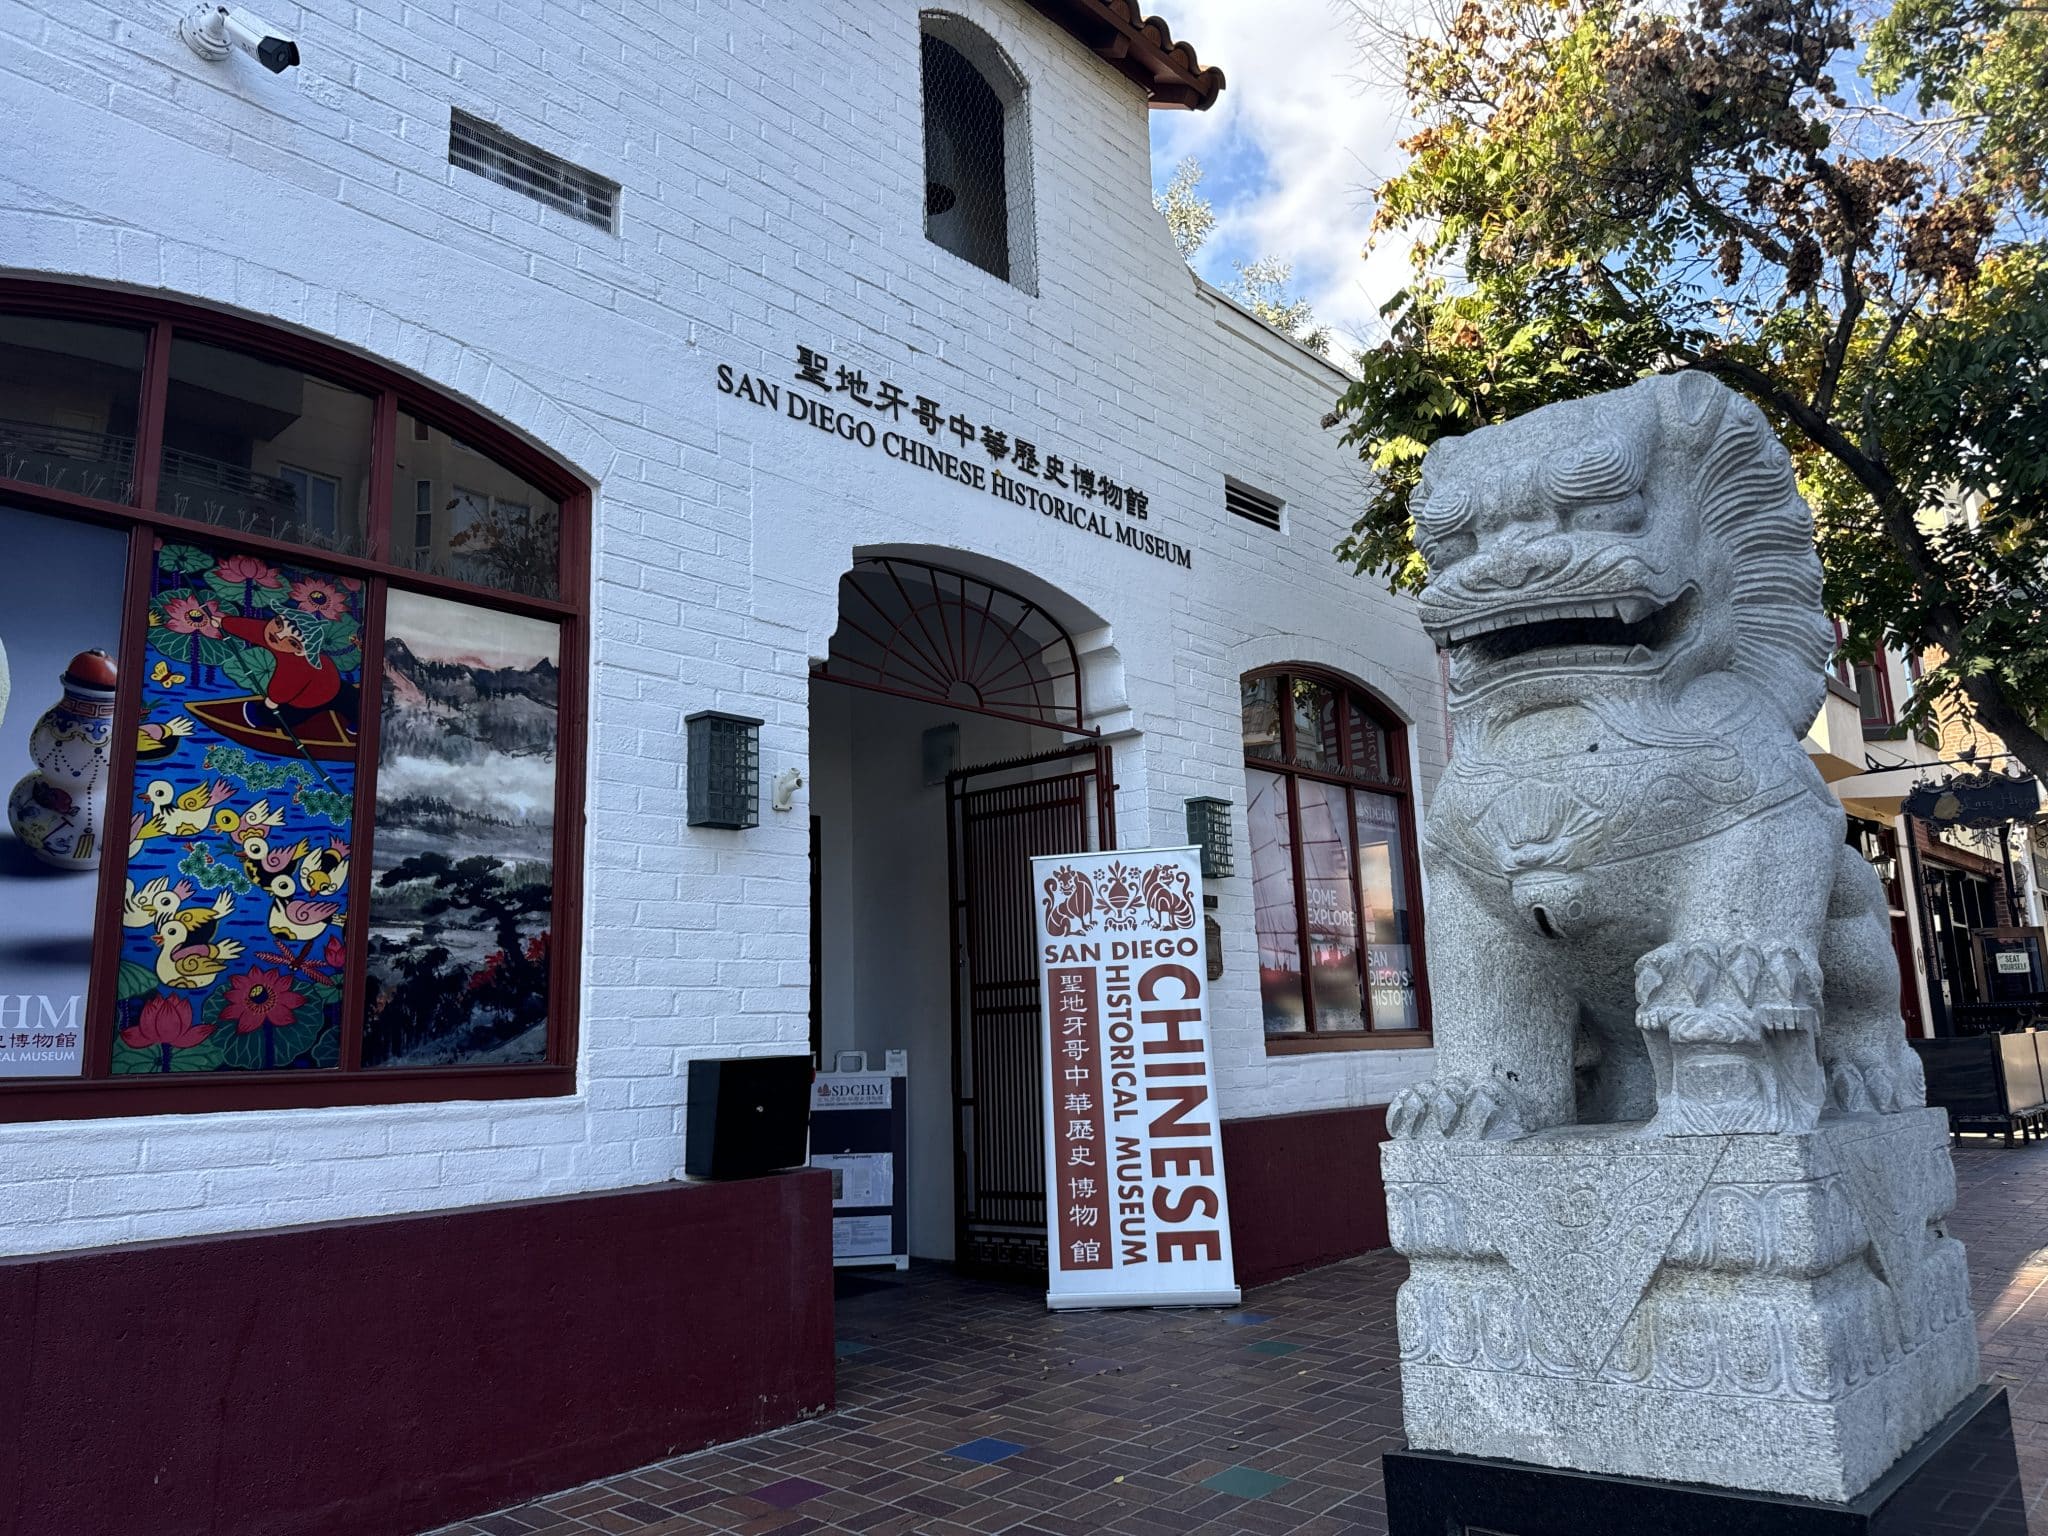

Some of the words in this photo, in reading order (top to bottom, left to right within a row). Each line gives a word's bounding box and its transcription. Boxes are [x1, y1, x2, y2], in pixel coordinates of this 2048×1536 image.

[794, 344, 1149, 521] 聖地牙哥中華歷史博物館
[717, 364, 779, 412] SAN
[787, 391, 876, 448] DIEGO
[882, 431, 986, 490] CHINESE
[992, 471, 1112, 540] HISTORICAL
[1115, 521, 1192, 570] MUSEUM
[1307, 888, 1338, 906] COME
[1308, 908, 1356, 927] EXPLORE
[1044, 941, 1101, 964] SAN
[1112, 935, 1199, 960] DIEGO
[1368, 950, 1388, 967] SAN
[1370, 970, 1409, 987] DIEGO'S
[1371, 989, 1413, 1006] HISTORY
[1104, 964, 1139, 1122] HISTORICAL
[20, 1051, 75, 1061] MUSEUM
[831, 1084, 883, 1096] SDCHM
[1060, 974, 1102, 1264] 聖地牙哥中華歷史博物館
[1137, 963, 1222, 1263] CHINESE
[1115, 1135, 1148, 1267] MUSEUM
